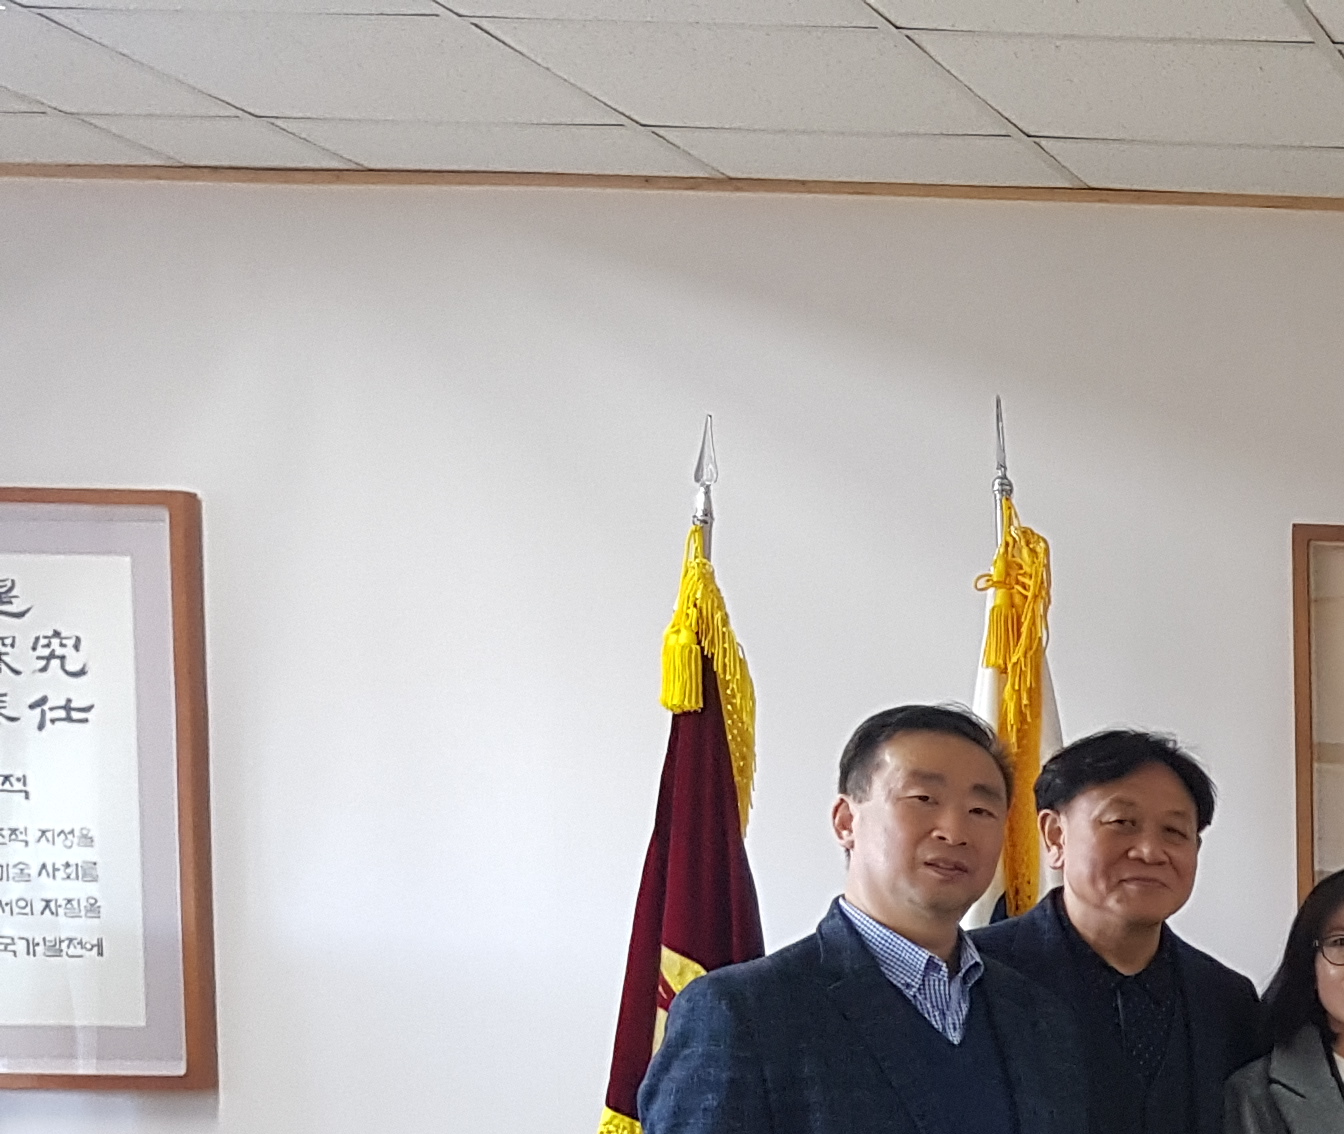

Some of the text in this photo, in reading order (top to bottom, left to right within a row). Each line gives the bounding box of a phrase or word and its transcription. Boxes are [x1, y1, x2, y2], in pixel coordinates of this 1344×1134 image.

[36, 826, 95, 849] 지성을
[37, 860, 99, 883] 사회를
[40, 895, 102, 919] 자질을
